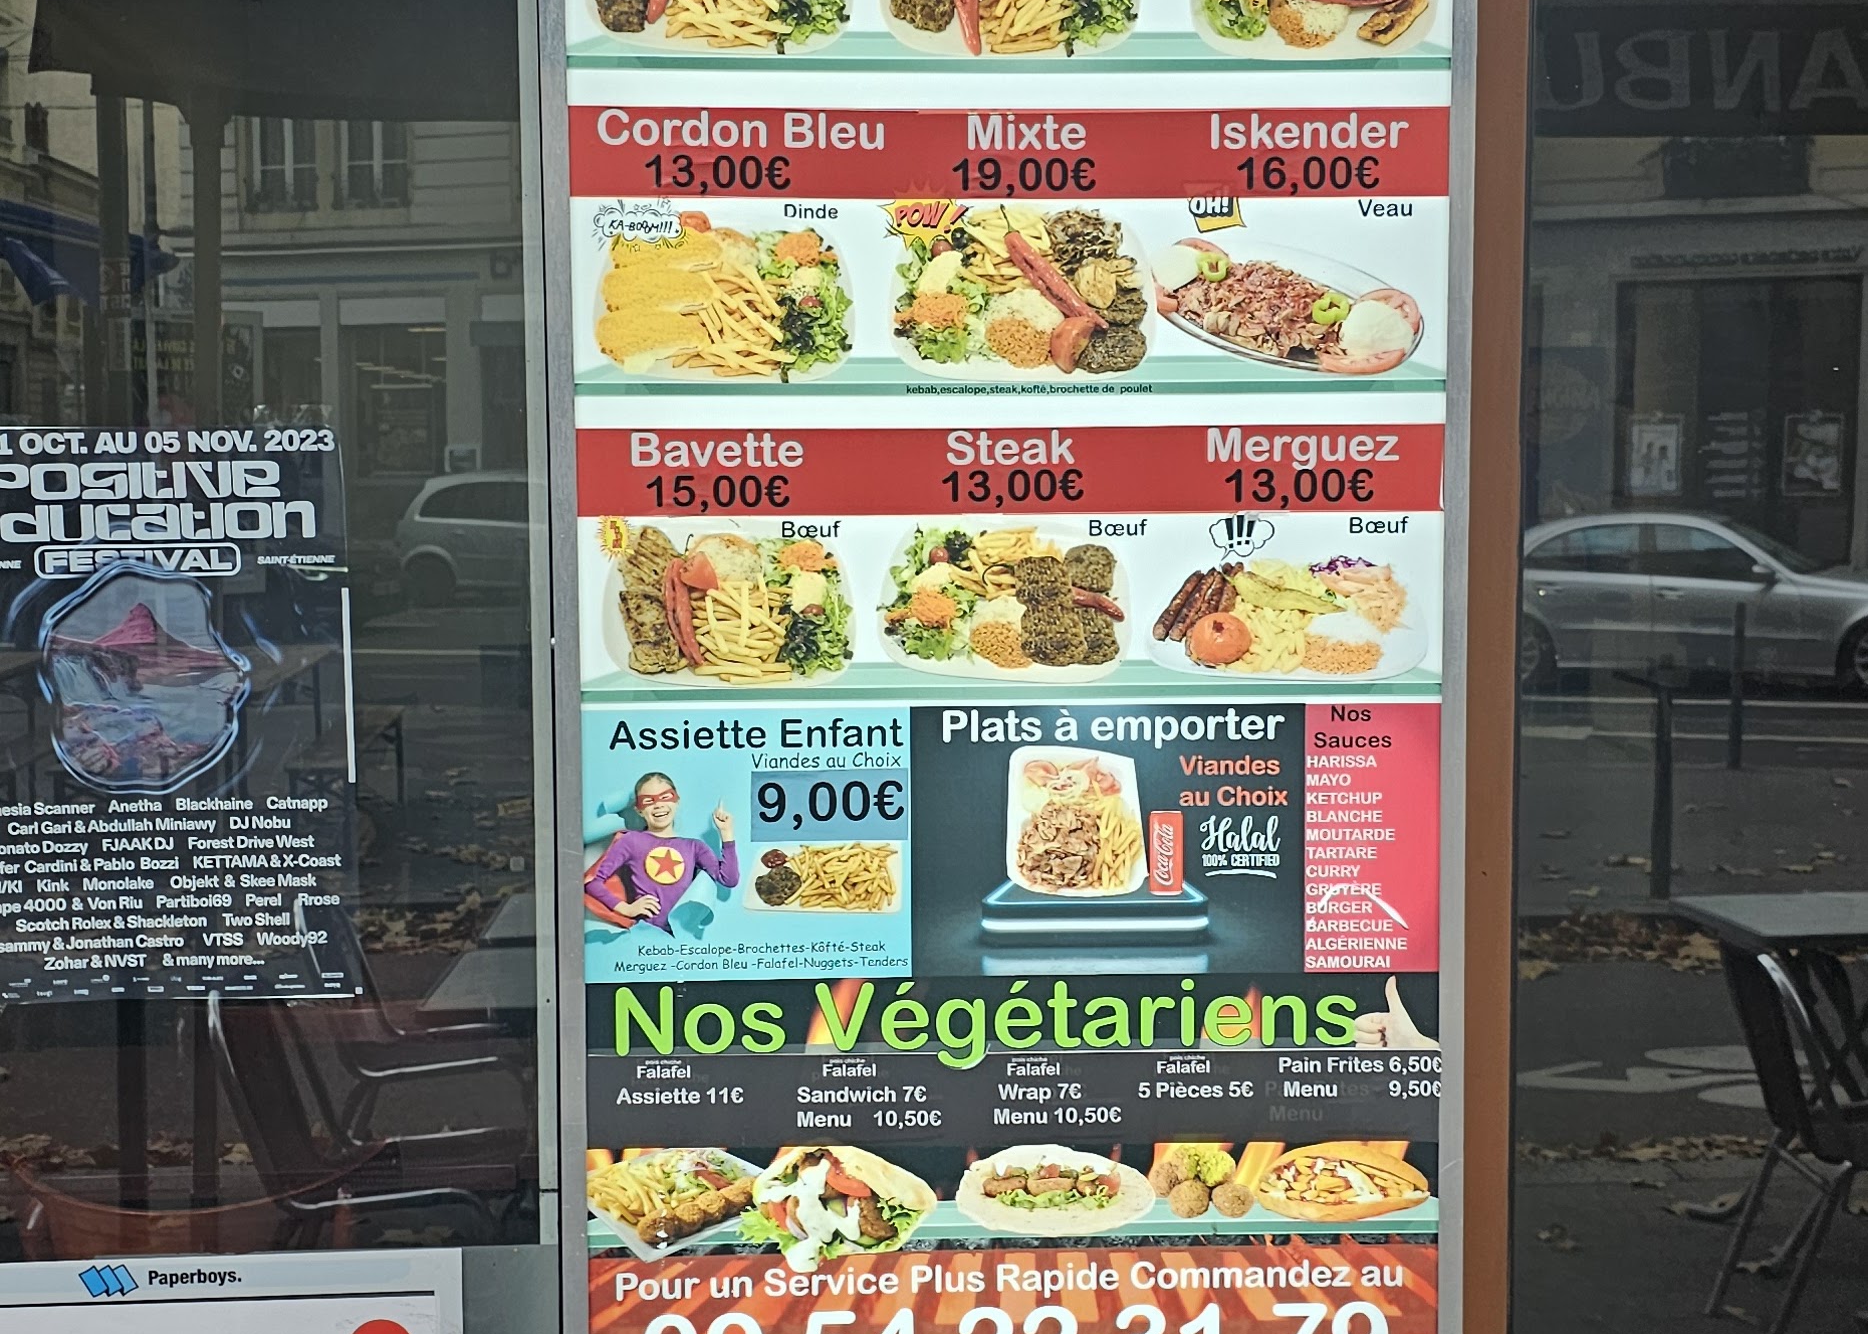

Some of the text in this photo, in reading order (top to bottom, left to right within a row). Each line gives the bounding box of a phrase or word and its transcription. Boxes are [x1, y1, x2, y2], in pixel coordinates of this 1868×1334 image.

[597, 109, 885, 150] Cordon Bleu
[784, 204, 838, 219] Dinde
[1102, 385, 1114, 393] de
[1120, 385, 1152, 395] poulet
[19, 430, 335, 454] OCT. AU 05 NOV. 2023
[1207, 426, 1399, 469] Merguez
[1349, 517, 1409, 535] Bœuf
[44, 549, 232, 573] FESTIVAL
[257, 555, 335, 564] SAINT-ÉTIENNE
[1331, 705, 1371, 722] Nos
[609, 718, 904, 750] Assiette Enfant
[942, 708, 1285, 749] Plats à emporter
[1314, 732, 1392, 748] Sauces
[1306, 755, 1377, 768] HARISSA
[757, 780, 905, 831] 9,00€
[1306, 793, 1382, 804] KETCHUP
[8, 816, 291, 836] Carl Gari & Abdullah Miniawy DJ Nobu
[1200, 815, 1281, 852] Halal
[1306, 829, 1395, 841] MOUTARDE
[1202, 854, 1280, 867] 100% CERTIFIED
[16, 912, 290, 932] Scotch Rolex & Shackleton Two Shell
[1306, 935, 1407, 950] ALGÉRIENNE
[44, 954, 264, 971] Zohar & NVST & many more...
[614, 961, 667, 974] Merguez
[723, 958, 747, 970] Bleu
[614, 978, 1358, 1069] Nos Végétariens
[636, 1065, 691, 1079] Falafel
[1278, 1057, 1442, 1076] Pain Frites 6,50€
[616, 1087, 744, 1106] Assiette 11€
[148, 1269, 242, 1287] Paperboys.
[616, 1259, 1403, 1301] Pour un Service Plus Rapide Commandez au
